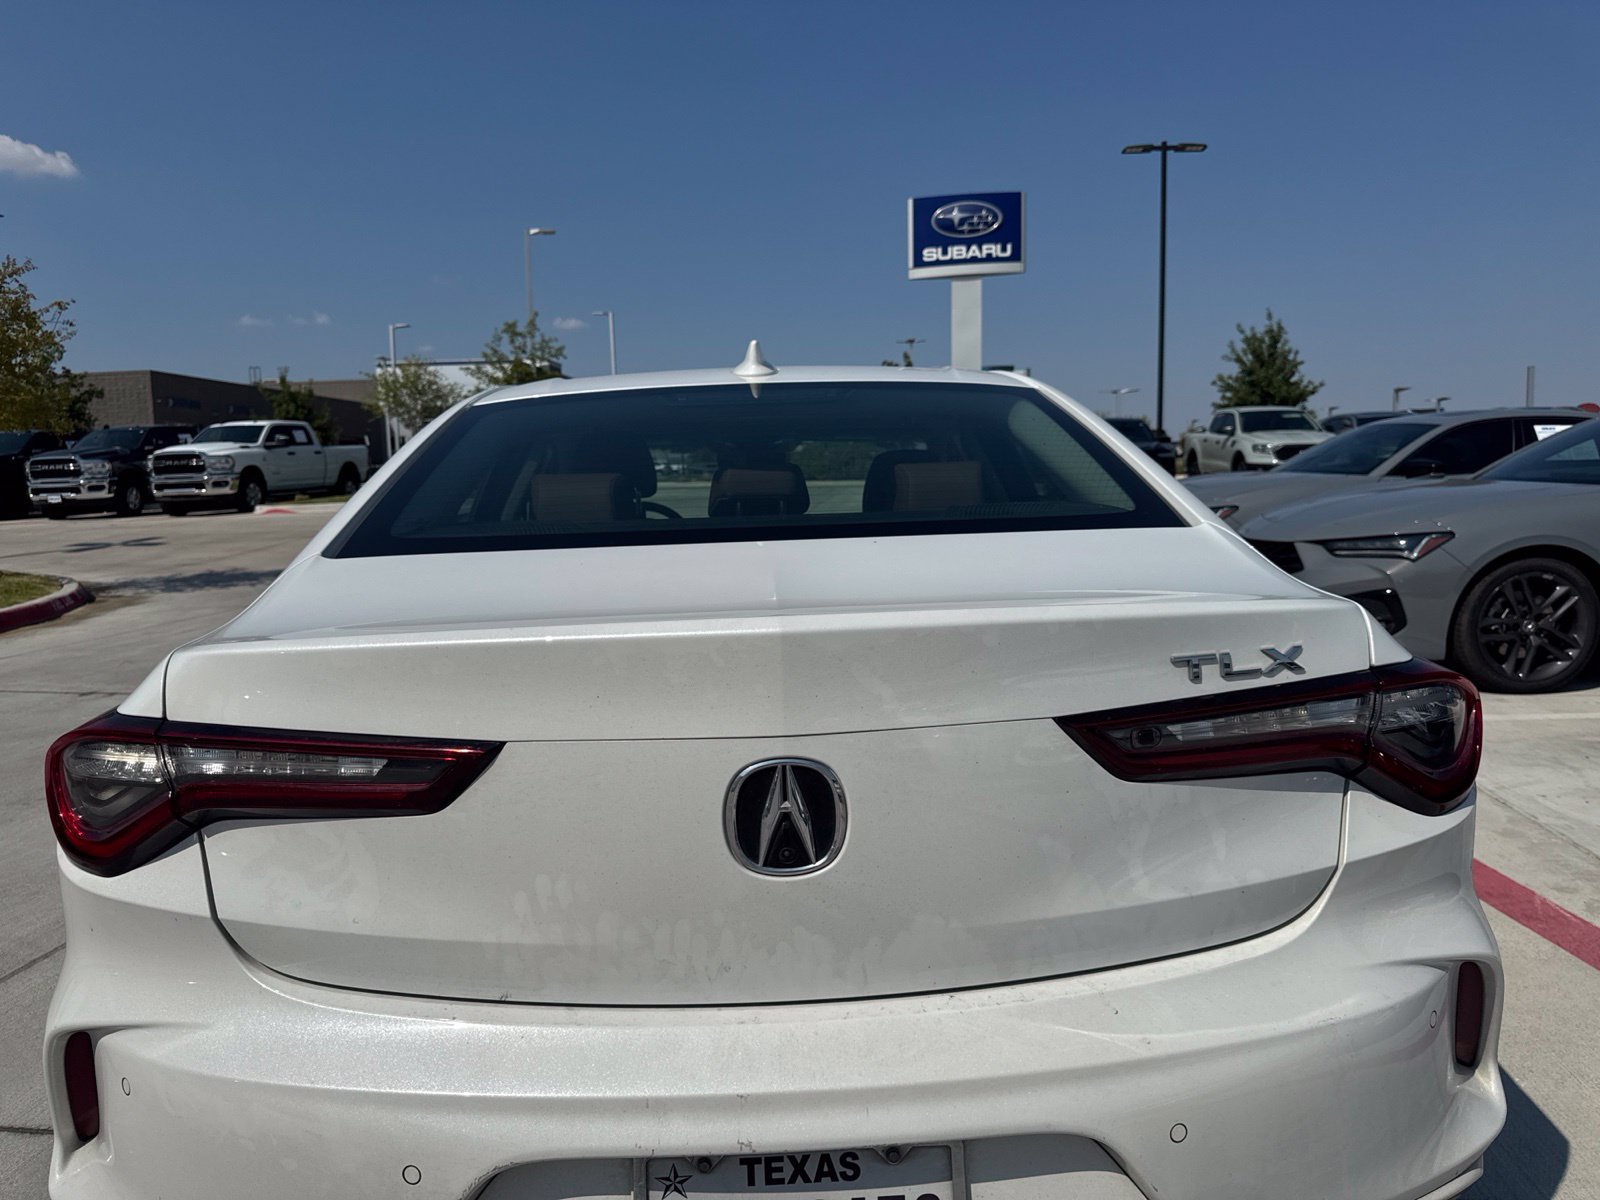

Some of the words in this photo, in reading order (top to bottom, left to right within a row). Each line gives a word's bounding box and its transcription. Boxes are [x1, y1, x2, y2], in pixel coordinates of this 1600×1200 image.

[922, 243, 1012, 262] SUBARU
[1170, 640, 1306, 684] TLX
[739, 1151, 861, 1187] TEXAS
